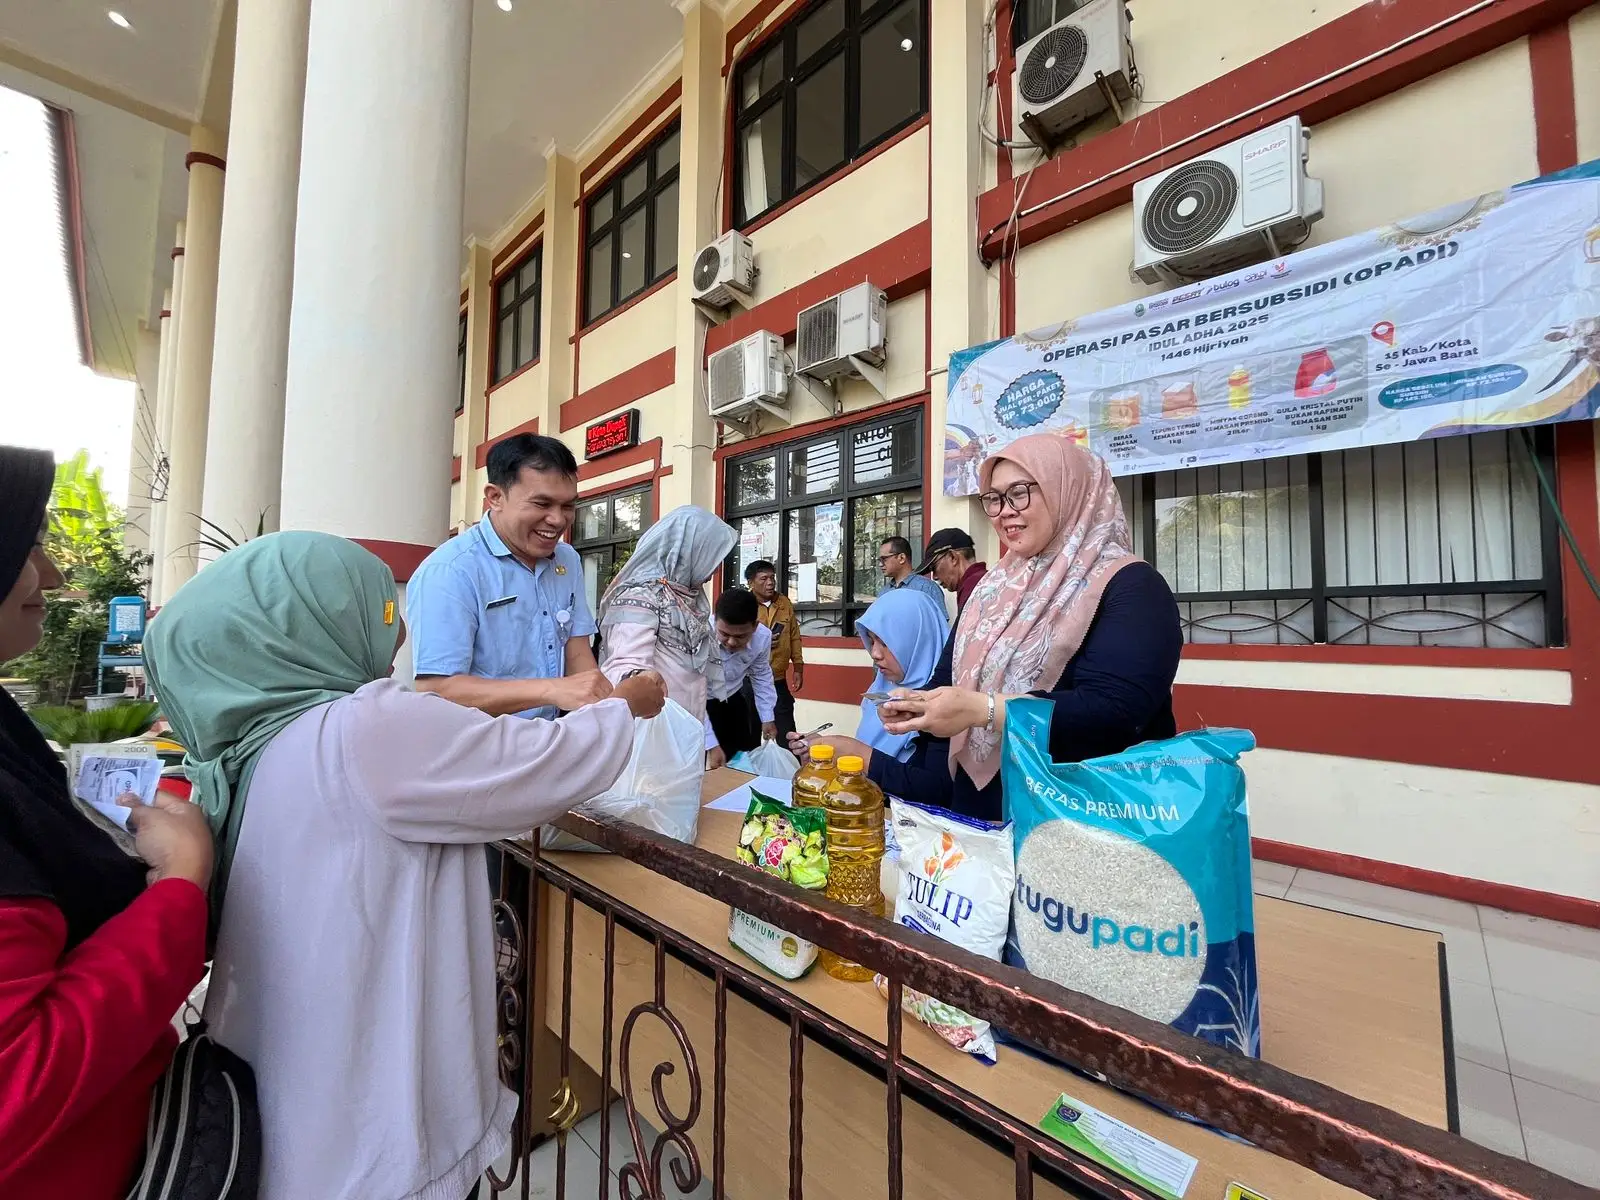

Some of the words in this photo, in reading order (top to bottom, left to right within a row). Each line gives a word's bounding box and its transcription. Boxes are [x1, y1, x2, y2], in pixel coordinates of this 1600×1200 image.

[1244, 139, 1287, 161] SHARP
[1213, 278, 1240, 292] bulog
[1043, 336, 1118, 363] OPERASI
[1121, 318, 1190, 345] PASAR
[1194, 277, 1337, 327] BERSUBSIDI
[1343, 241, 1460, 286] (OPADI)
[1149, 333, 1179, 353] IDUL
[1183, 324, 1225, 344] ADHA
[1227, 314, 1269, 333] 2025
[1161, 348, 1191, 361] 1446
[1193, 335, 1249, 355] Hijriyah
[1375, 363, 1392, 371] Se
[1402, 356, 1437, 368] Jawa
[1440, 346, 1479, 361] Barat
[1384, 351, 1399, 360] 15
[1402, 338, 1472, 357] Kab/Kota
[1007, 378, 1045, 403] HARGA
[1276, 406, 1297, 414] GULA
[1300, 401, 1335, 411] KRISTAL
[1337, 396, 1363, 405] PUTIH
[1285, 411, 1313, 420] BUKAN
[1240, 417, 1274, 427] PREMIUM
[1291, 416, 1331, 426] KEMASAN
[1109, 439, 1138, 447] KEMASAN
[1113, 433, 1133, 441] BERAS
[1153, 431, 1185, 440] KEMASAN
[1025, 775, 1080, 811] BERAS
[1085, 800, 1180, 822] PREMIUM
[907, 871, 973, 928] TULIP
[736, 910, 775, 941] PREMIUM
[1016, 873, 1200, 959] tugupadi
